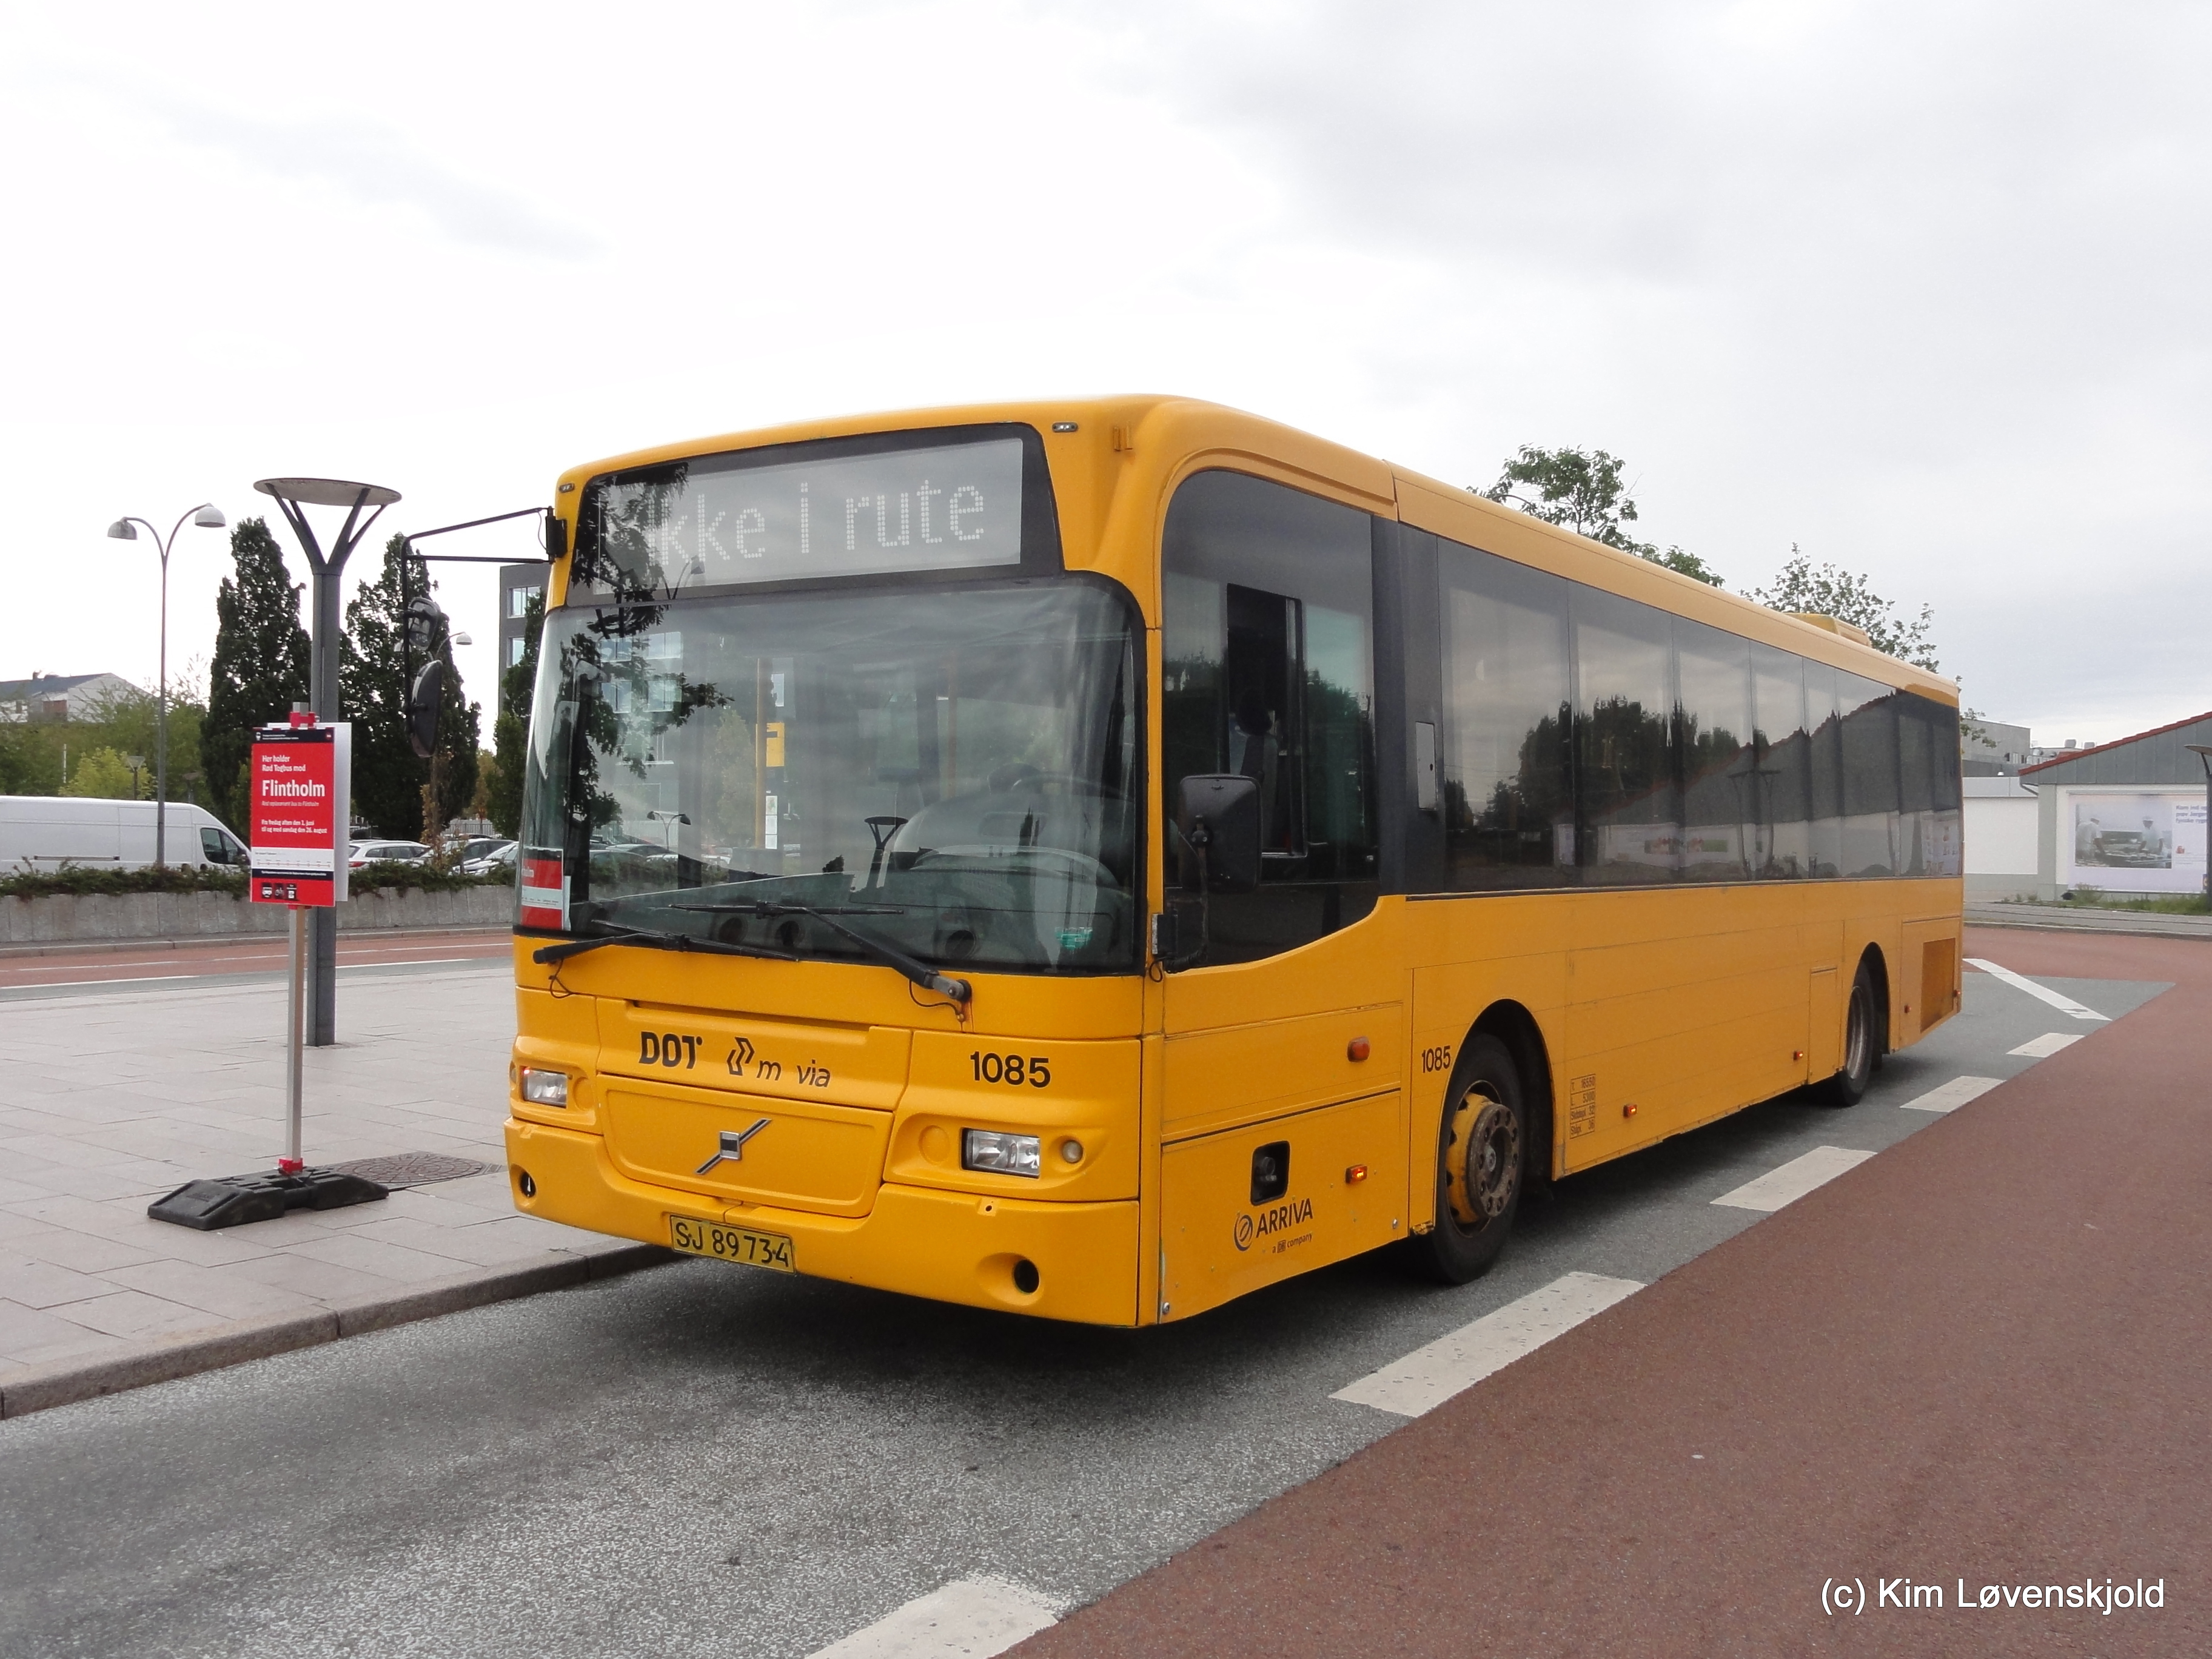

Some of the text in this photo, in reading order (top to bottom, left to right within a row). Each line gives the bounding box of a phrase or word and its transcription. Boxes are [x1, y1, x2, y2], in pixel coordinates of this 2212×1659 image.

[801, 482, 809, 554] i
[846, 480, 984, 551] rute
[262, 779, 325, 797] Flintholm
[638, 1031, 703, 1070] DOT
[1421, 1045, 1451, 1073] 1085
[970, 1051, 1051, 1088] 1085
[1256, 1198, 1313, 1238] ARRIVA
[675, 1222, 703, 1250] SJ
[1287, 1233, 1313, 1248] company
